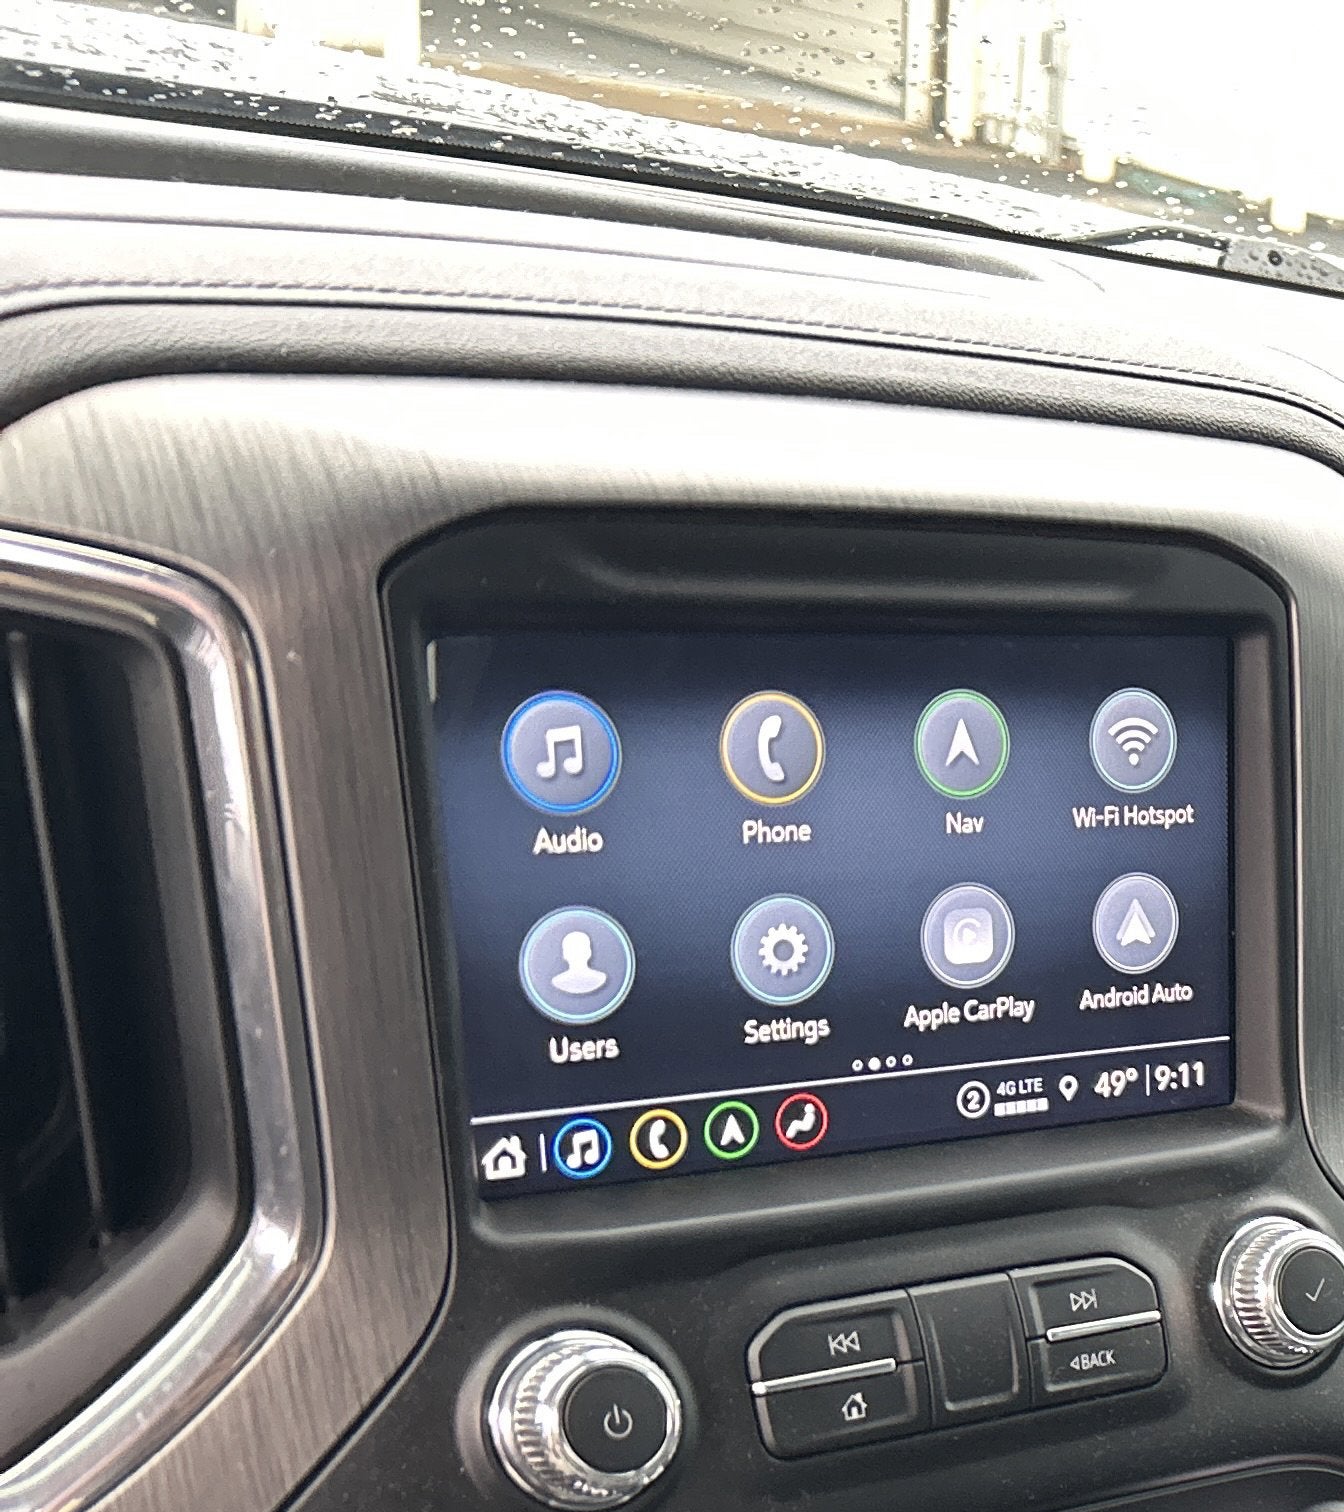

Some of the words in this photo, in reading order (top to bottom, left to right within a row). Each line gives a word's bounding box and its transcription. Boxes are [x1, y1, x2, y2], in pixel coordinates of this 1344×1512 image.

[945, 811, 984, 834] Nav
[1072, 805, 1120, 828] Wi-Fi
[1123, 804, 1195, 830] Hotspot
[532, 824, 603, 855] Audio
[742, 819, 812, 845] Phone
[1079, 984, 1149, 1010] Android
[1152, 983, 1194, 1004] Auto
[904, 1002, 960, 1032] Apple
[963, 996, 1035, 1023] CarPlay
[744, 1017, 831, 1046] Settings
[549, 1036, 620, 1064] Users
[997, 1081, 1017, 1096] 4G
[1018, 1078, 1043, 1095] LTE
[1154, 1061, 1205, 1091] 9:11
[1080, 1349, 1117, 1370] BACK
